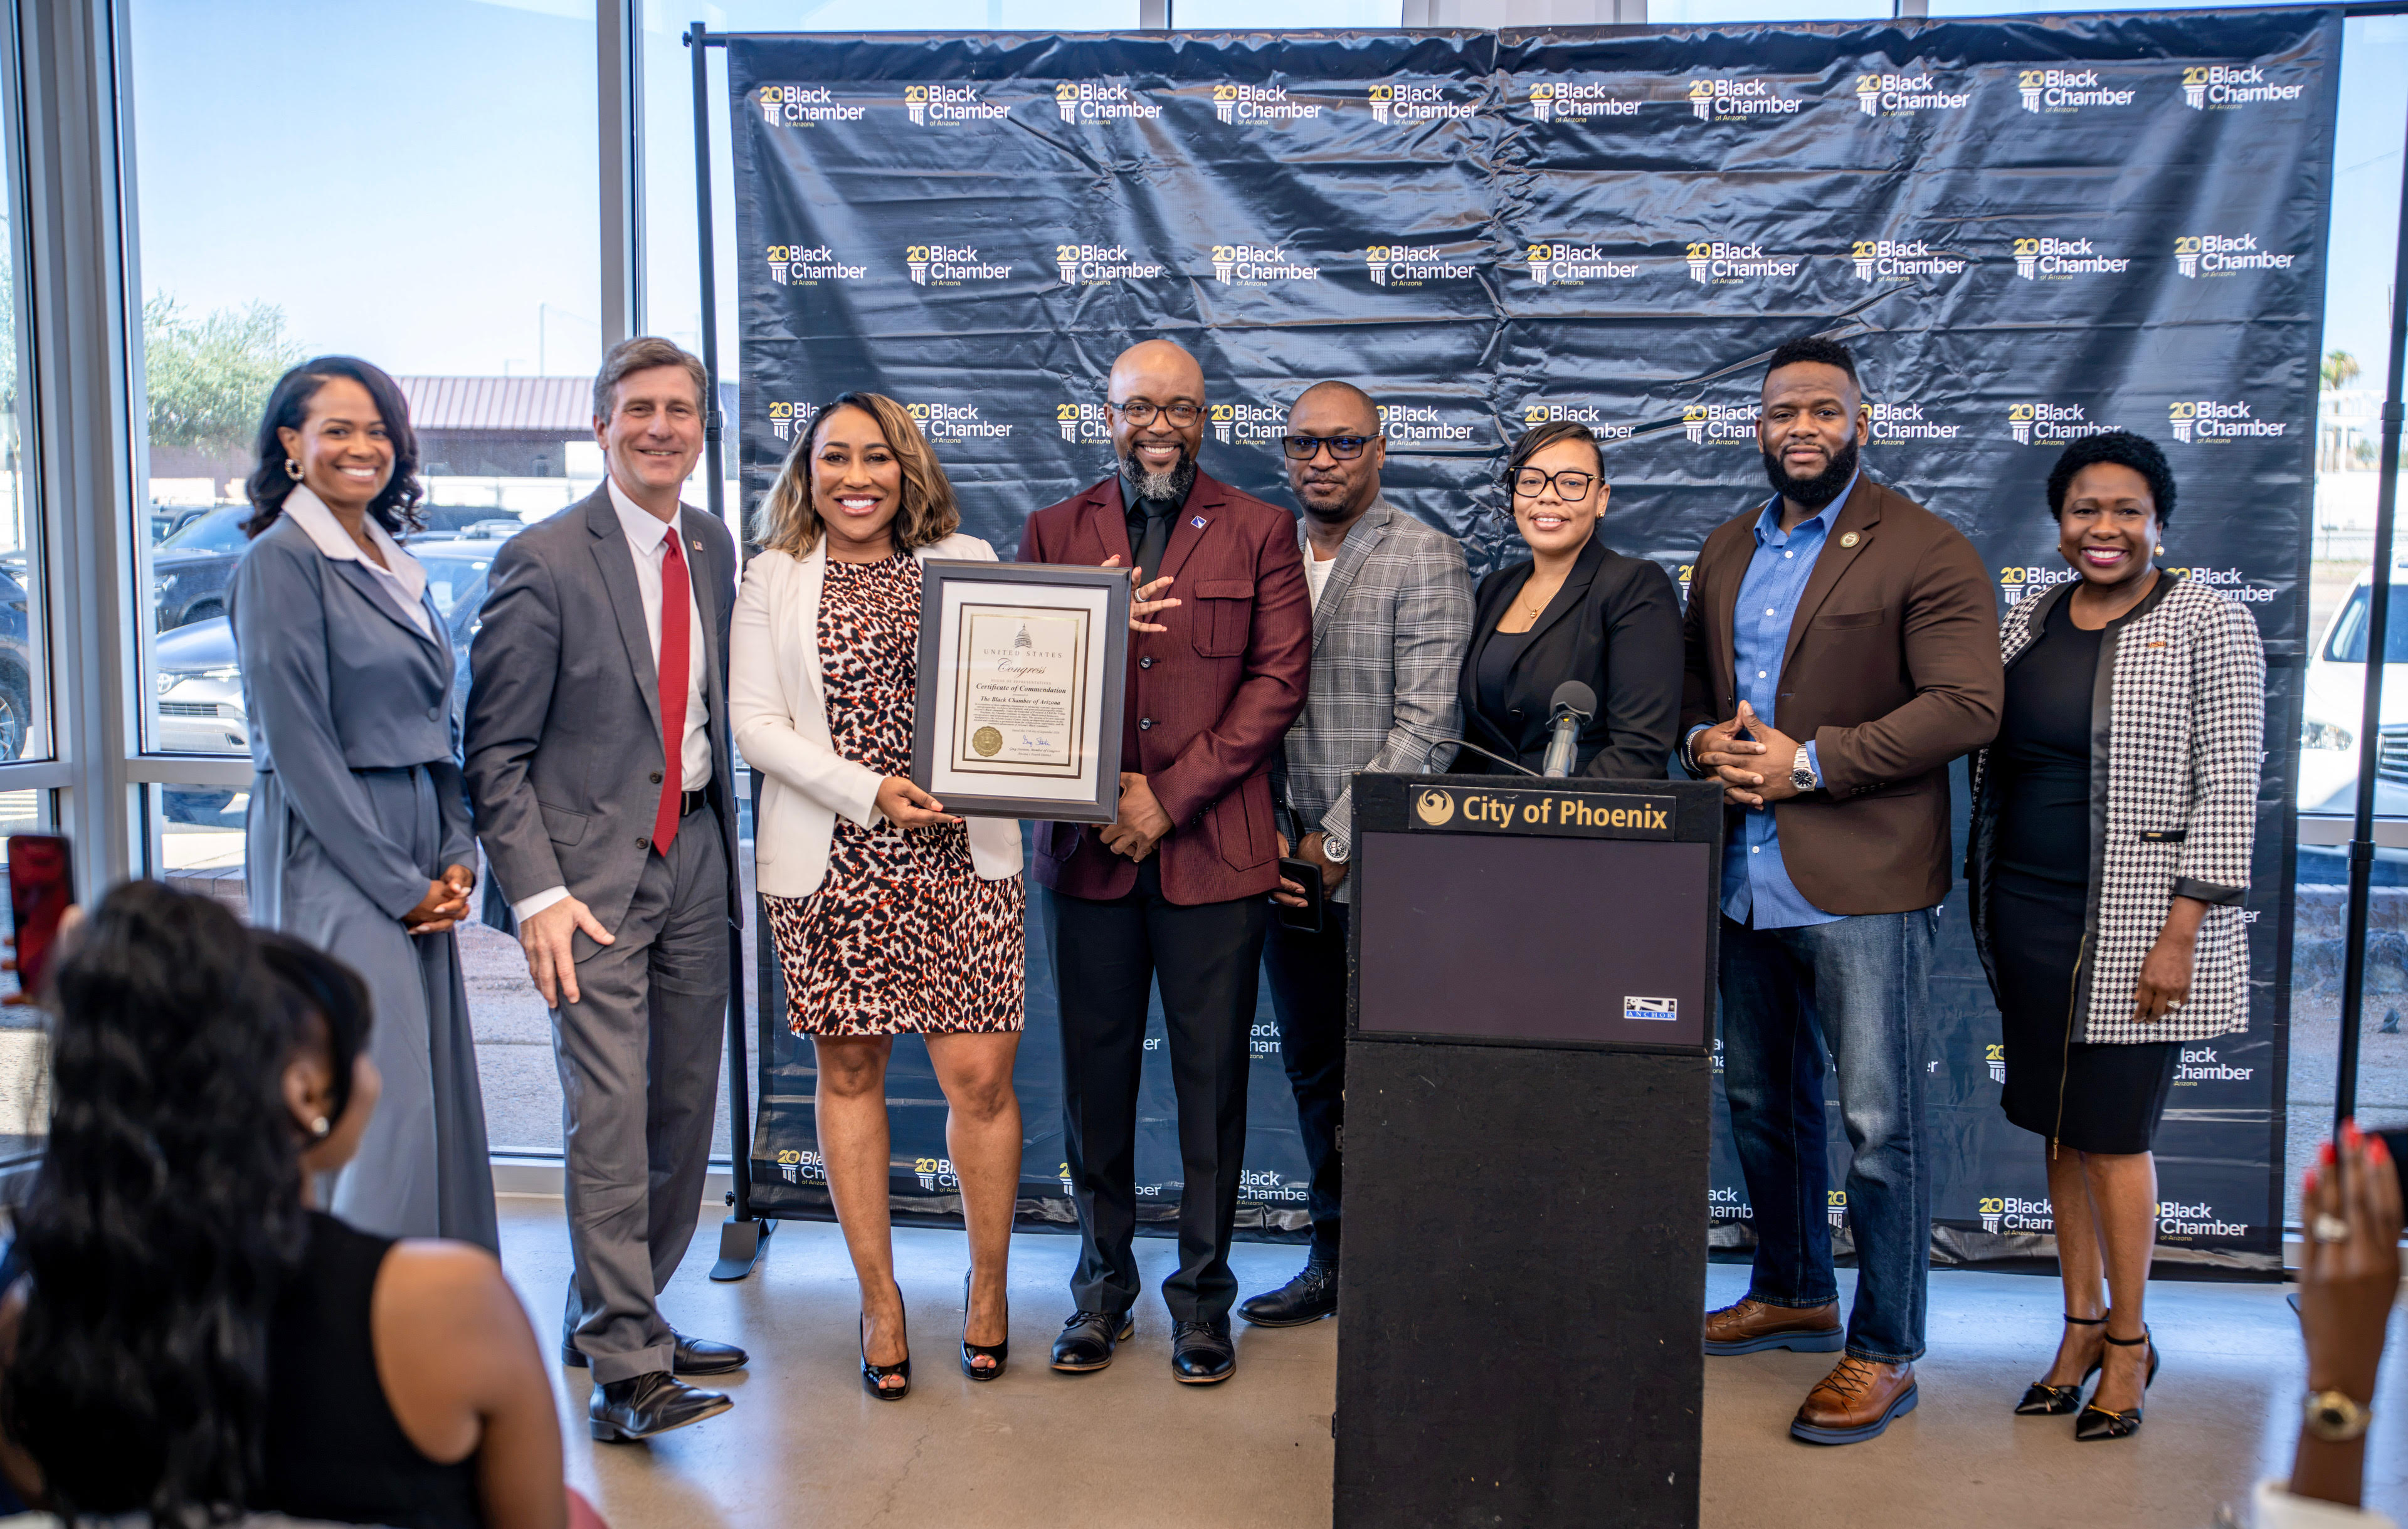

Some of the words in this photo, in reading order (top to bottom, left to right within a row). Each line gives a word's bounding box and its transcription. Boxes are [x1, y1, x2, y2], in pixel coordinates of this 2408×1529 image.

[1883, 73, 1933, 92] Black
[2046, 68, 2098, 87] Black
[2210, 64, 2263, 84] Black
[784, 86, 831, 103] Black
[929, 85, 976, 102] Black
[1080, 83, 1127, 100] Black
[1238, 85, 1287, 101] Black
[1394, 84, 1443, 101] Black
[1555, 81, 1605, 98] Black
[1715, 78, 1765, 96] Black
[2045, 85, 2135, 106] Chamber
[2209, 80, 2301, 103] Chamber
[1555, 97, 1641, 116] Chamber
[1715, 94, 1802, 114] Chamber
[1883, 89, 1969, 110] Chamber
[784, 102, 865, 120] Chamber
[929, 101, 1011, 119] Chamber
[1080, 100, 1162, 118] Chamber
[1238, 101, 1322, 118] Chamber
[1393, 100, 1478, 118] Chamber
[1712, 241, 1762, 260] Black
[1877, 239, 1928, 257] Black
[2041, 237, 2092, 255] Black
[2202, 233, 2256, 253] Black
[790, 245, 832, 262] Black
[931, 245, 977, 262] Black
[1080, 244, 1127, 261] Black
[1237, 246, 1285, 262] Black
[1391, 244, 1439, 262] Black
[1553, 244, 1602, 261] Black
[2202, 248, 2295, 271] Chamber
[791, 262, 867, 278] Chamber
[931, 261, 1011, 279] Chamber
[1081, 261, 1161, 278] Chamber
[1237, 262, 1320, 279] Chamber
[1391, 261, 1475, 280] Chamber
[1553, 260, 1638, 278] Chamber
[1712, 258, 1798, 277] Chamber
[1877, 255, 1965, 275] Chamber
[2040, 253, 2130, 273] Chamber
[794, 402, 820, 418] Bla
[931, 403, 979, 420] Black
[1080, 404, 1106, 420] Bla
[1235, 404, 1283, 421] Black
[1389, 405, 1439, 421] Black
[1550, 405, 1600, 421] Black
[1708, 404, 1758, 421] Black
[1873, 404, 1924, 421] Black
[2034, 403, 2085, 421] Black
[2196, 401, 2251, 419] Black
[931, 421, 1013, 436] Chamber
[1235, 421, 1287, 438] Cham
[1390, 422, 1473, 439] Chamber
[1588, 423, 1635, 438] mber
[1873, 421, 1960, 438] Chamber
[2196, 419, 2286, 437] Chamber
[2027, 567, 2079, 584] Black
[2191, 567, 2242, 584] Black
[998, 658, 1047, 678] Congress
[976, 683, 1009, 692] Certificate
[1019, 685, 1066, 693] Commendation
[1463, 796, 1515, 828] City
[1524, 798, 1553, 823] of
[1560, 800, 1668, 829] Phoenix
[1250, 1021, 1281, 1036] ack
[2180, 1047, 2217, 1063] lack
[800, 1151, 823, 1165] Bla
[1708, 1187, 1738, 1202] ack
[2004, 1197, 2052, 1214] Black
[2160, 1201, 2212, 1218] Black
[2160, 1218, 2248, 1236] Chamber
